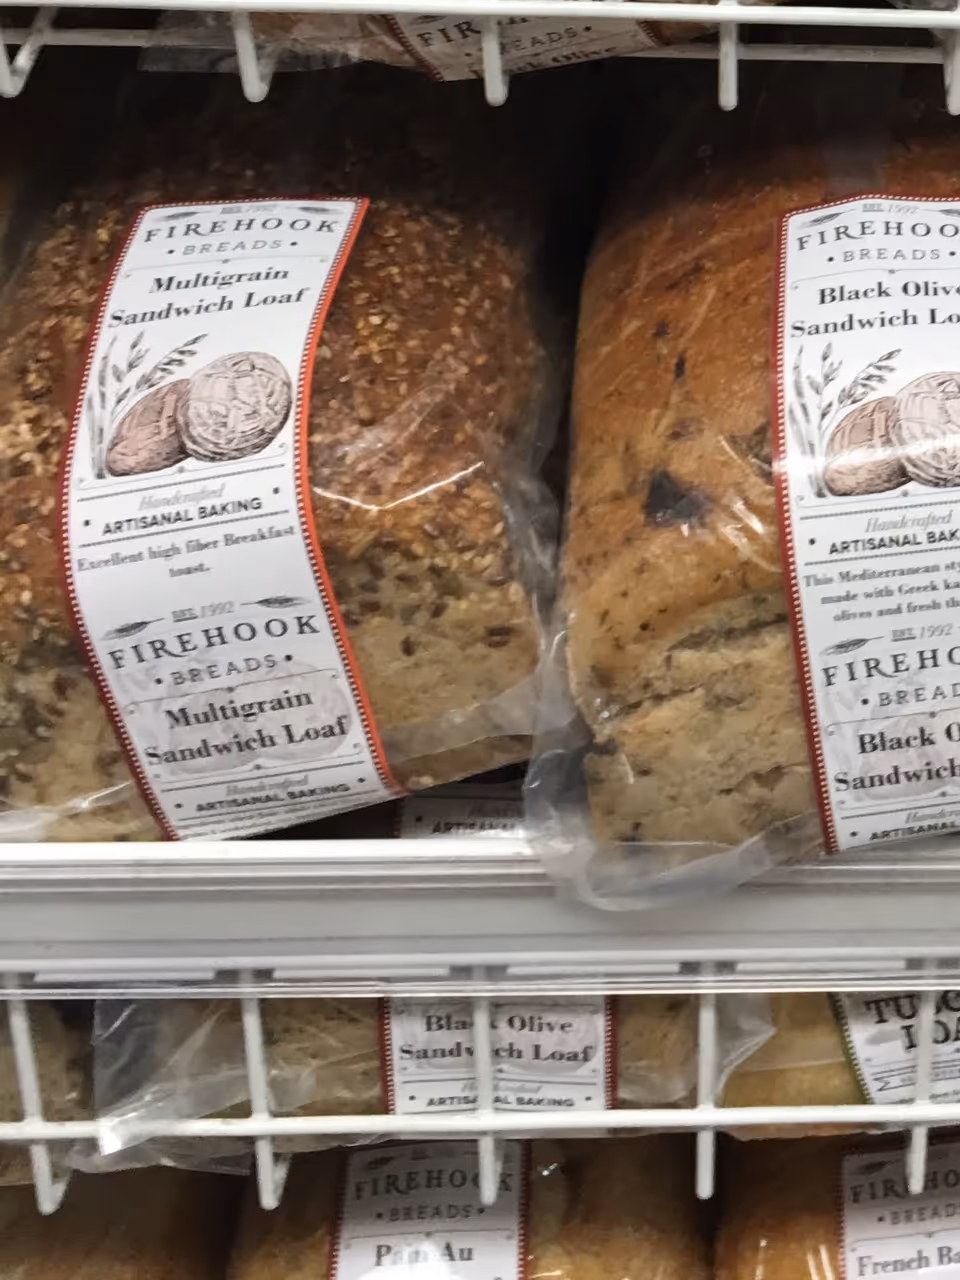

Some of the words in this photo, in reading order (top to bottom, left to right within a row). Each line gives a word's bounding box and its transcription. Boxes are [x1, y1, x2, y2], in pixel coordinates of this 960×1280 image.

[143, 217, 338, 243] FIREHOOK
[182, 239, 282, 256] BREADS
[843, 248, 941, 263] BREADS
[149, 266, 290, 294] Multigrain
[818, 281, 892, 305] Black
[107, 295, 234, 328] Sandwich
[242, 287, 310, 309] Loaf
[789, 308, 921, 339] Sandwich
[101, 508, 194, 536] ARTISANAL
[199, 497, 263, 519] BAKING
[223, 524, 297, 547] Breakfast
[829, 534, 923, 555] ARTISANAL
[107, 614, 321, 671] FIREHOOK
[170, 654, 278, 686] BREADS
[165, 689, 314, 729] Multigrain
[143, 728, 276, 766] Sandwich
[280, 714, 351, 744] Loaf
[858, 725, 937, 754] Black
[508, 1014, 574, 1034] Olive
[532, 1044, 595, 1063] Loaf
[856, 1249, 930, 1277] French
